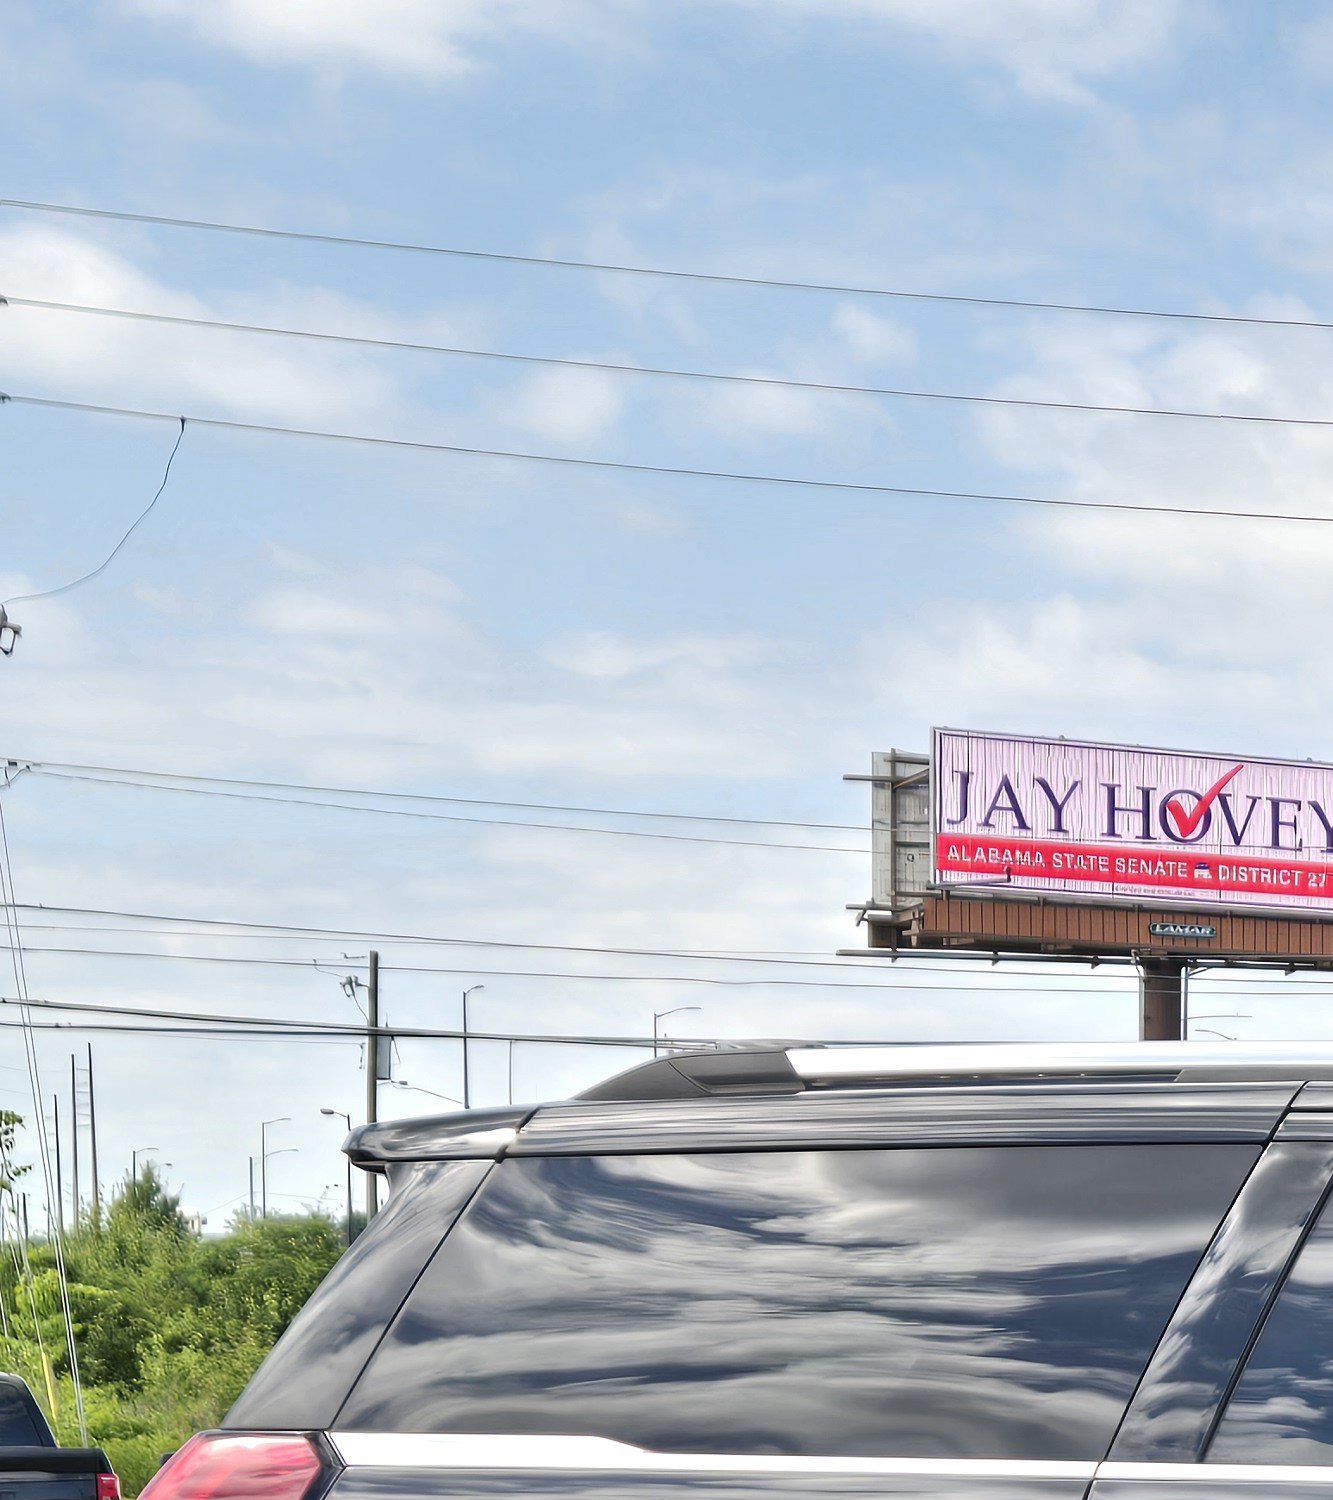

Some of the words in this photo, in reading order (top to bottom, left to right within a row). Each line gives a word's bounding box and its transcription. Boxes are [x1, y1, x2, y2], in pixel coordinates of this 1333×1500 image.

[946, 770, 1082, 834] JAY
[947, 845, 1046, 869] ALABAMA
[1052, 853, 1110, 873] STATE
[1115, 857, 1189, 879] SENATE
[1218, 863, 1303, 888] DISTRICT
[1307, 872, 1328, 889] 27
